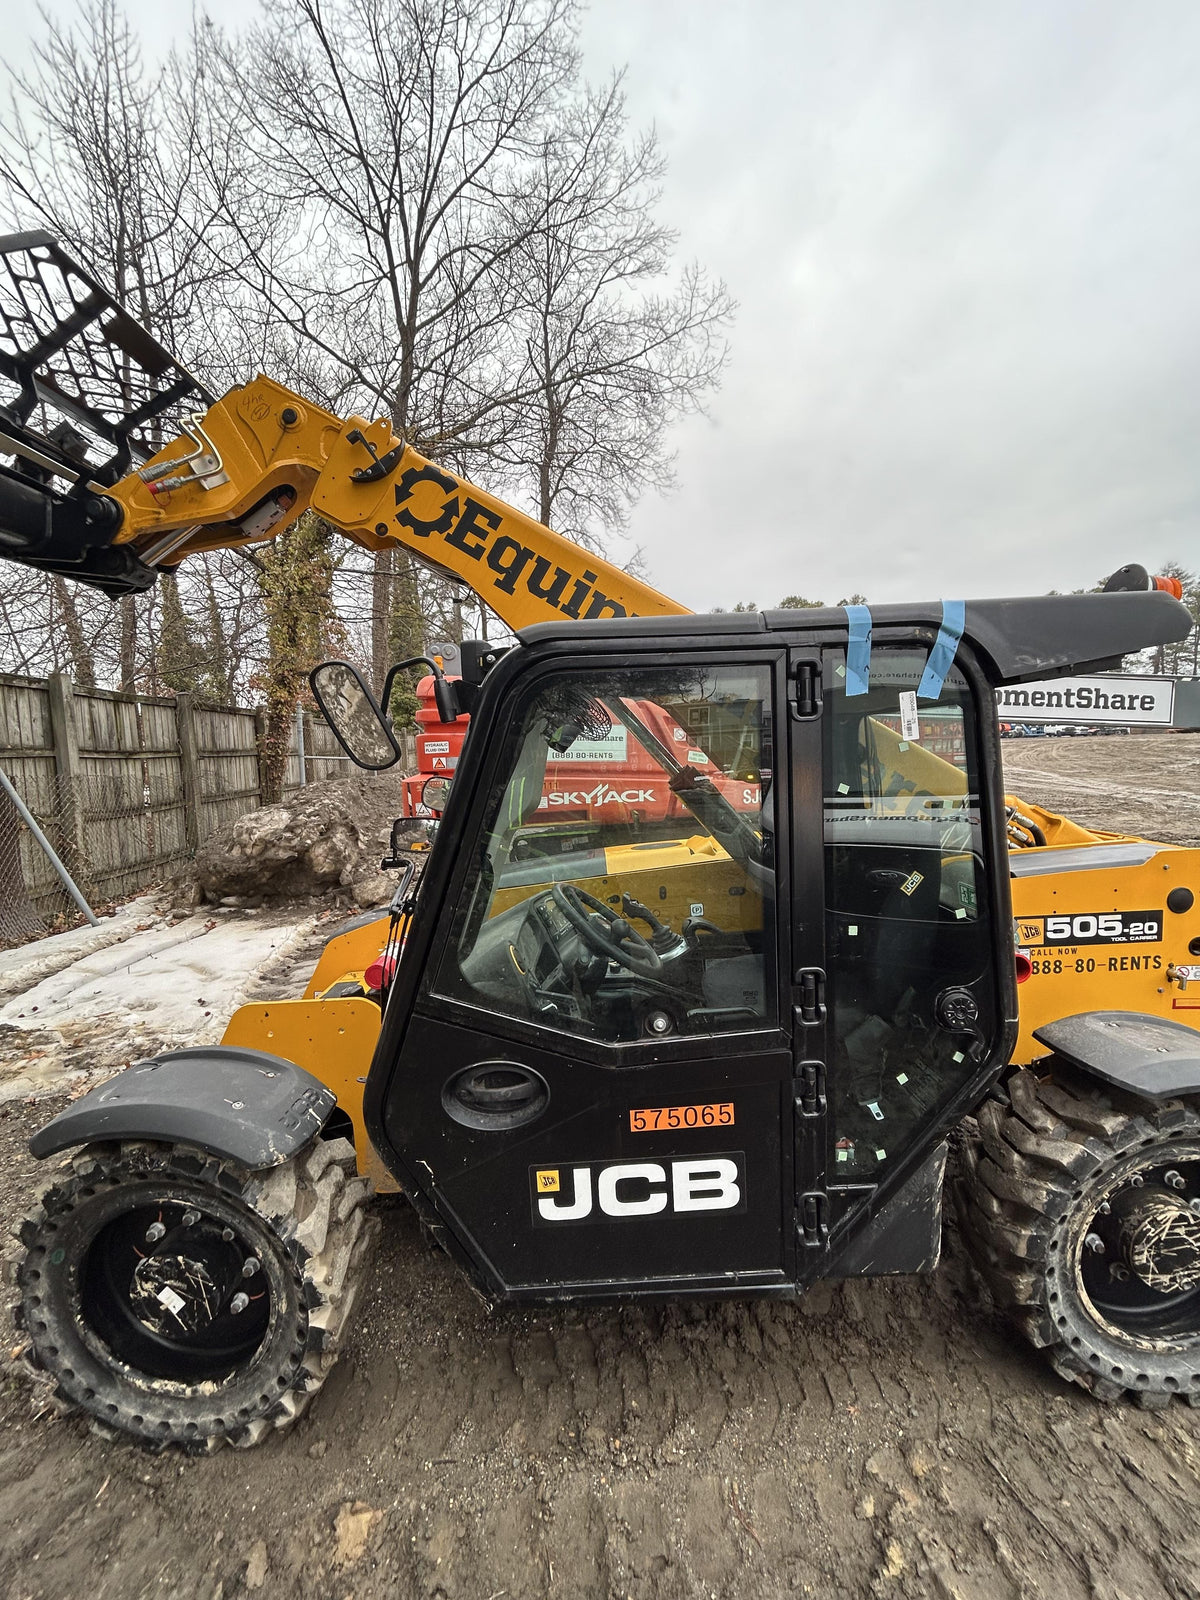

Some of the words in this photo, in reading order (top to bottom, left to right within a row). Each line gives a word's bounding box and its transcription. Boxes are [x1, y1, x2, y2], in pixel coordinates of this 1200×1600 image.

[548, 783, 657, 807] SKYJACK
[743, 789, 761, 804] SJ
[906, 874, 921, 892] JCB
[1024, 925, 1040, 939] JCB
[1046, 914, 1158, 939] 505-20
[1058, 947, 1078, 955] NOW
[633, 1104, 732, 1130] 575065
[538, 1159, 740, 1221] JCB
